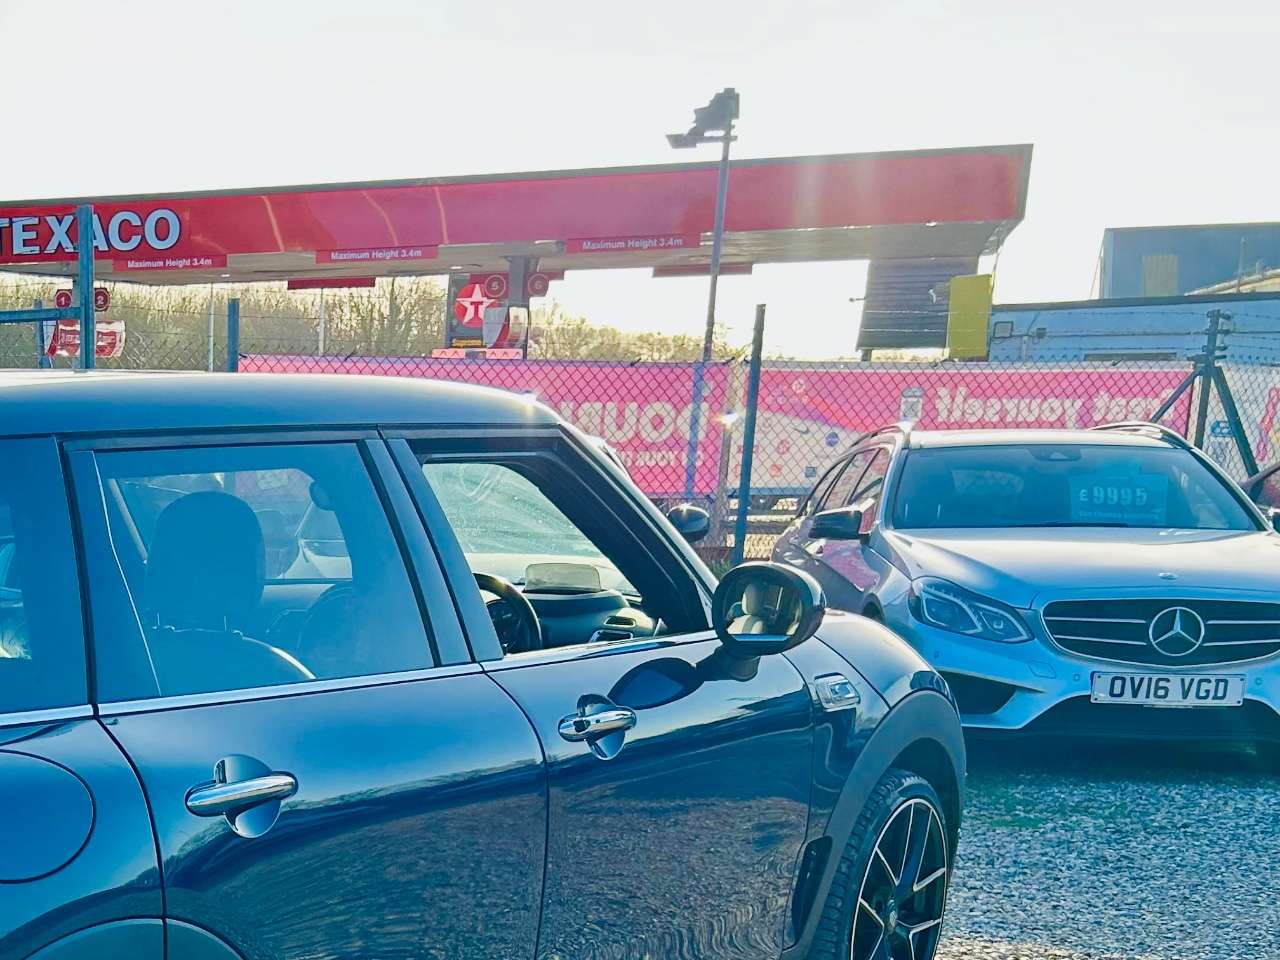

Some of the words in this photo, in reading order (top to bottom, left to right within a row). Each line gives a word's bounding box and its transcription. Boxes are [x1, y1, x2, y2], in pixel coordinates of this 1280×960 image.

[583, 240, 625, 250] Maximum
[627, 238, 657, 249] Height
[659, 237, 683, 248] 3.4m
[331, 250, 370, 260] Maximum
[371, 249, 399, 260] Height
[400, 248, 422, 258] 3.4m
[127, 259, 164, 268] Maximum
[165, 257, 191, 269] Height
[192, 257, 212, 267] 3.4m
[1108, 675, 1171, 699] OV16
[1180, 677, 1229, 701] VGD
